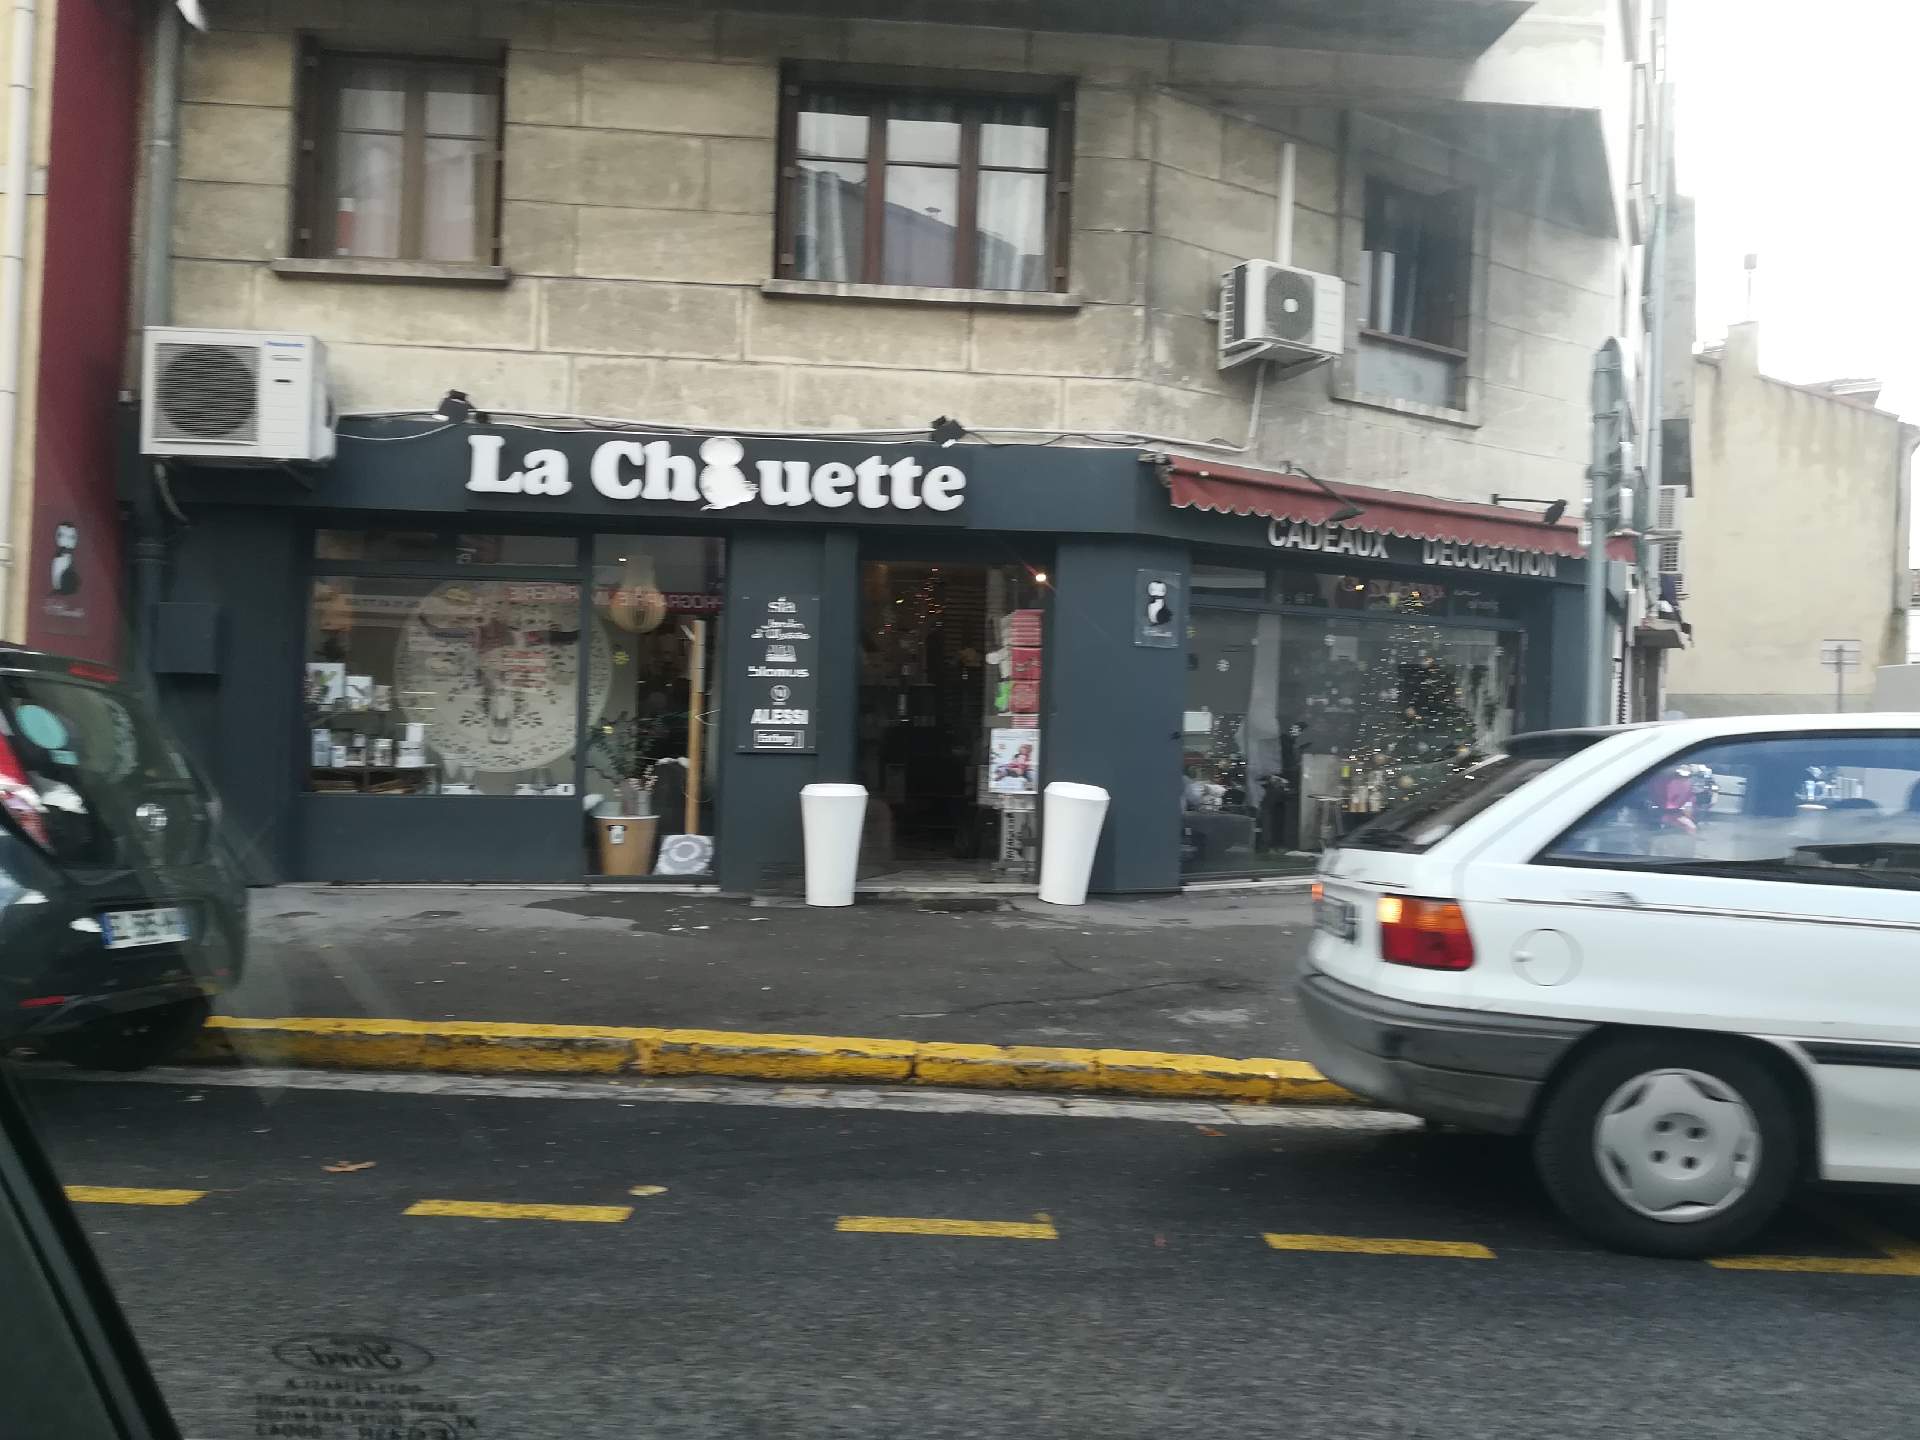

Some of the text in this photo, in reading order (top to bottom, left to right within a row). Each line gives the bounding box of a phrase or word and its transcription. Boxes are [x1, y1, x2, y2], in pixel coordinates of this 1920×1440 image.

[465, 434, 573, 496] La
[1266, 519, 1391, 560] CADEAUX
[750, 708, 809, 725] ALESSI
